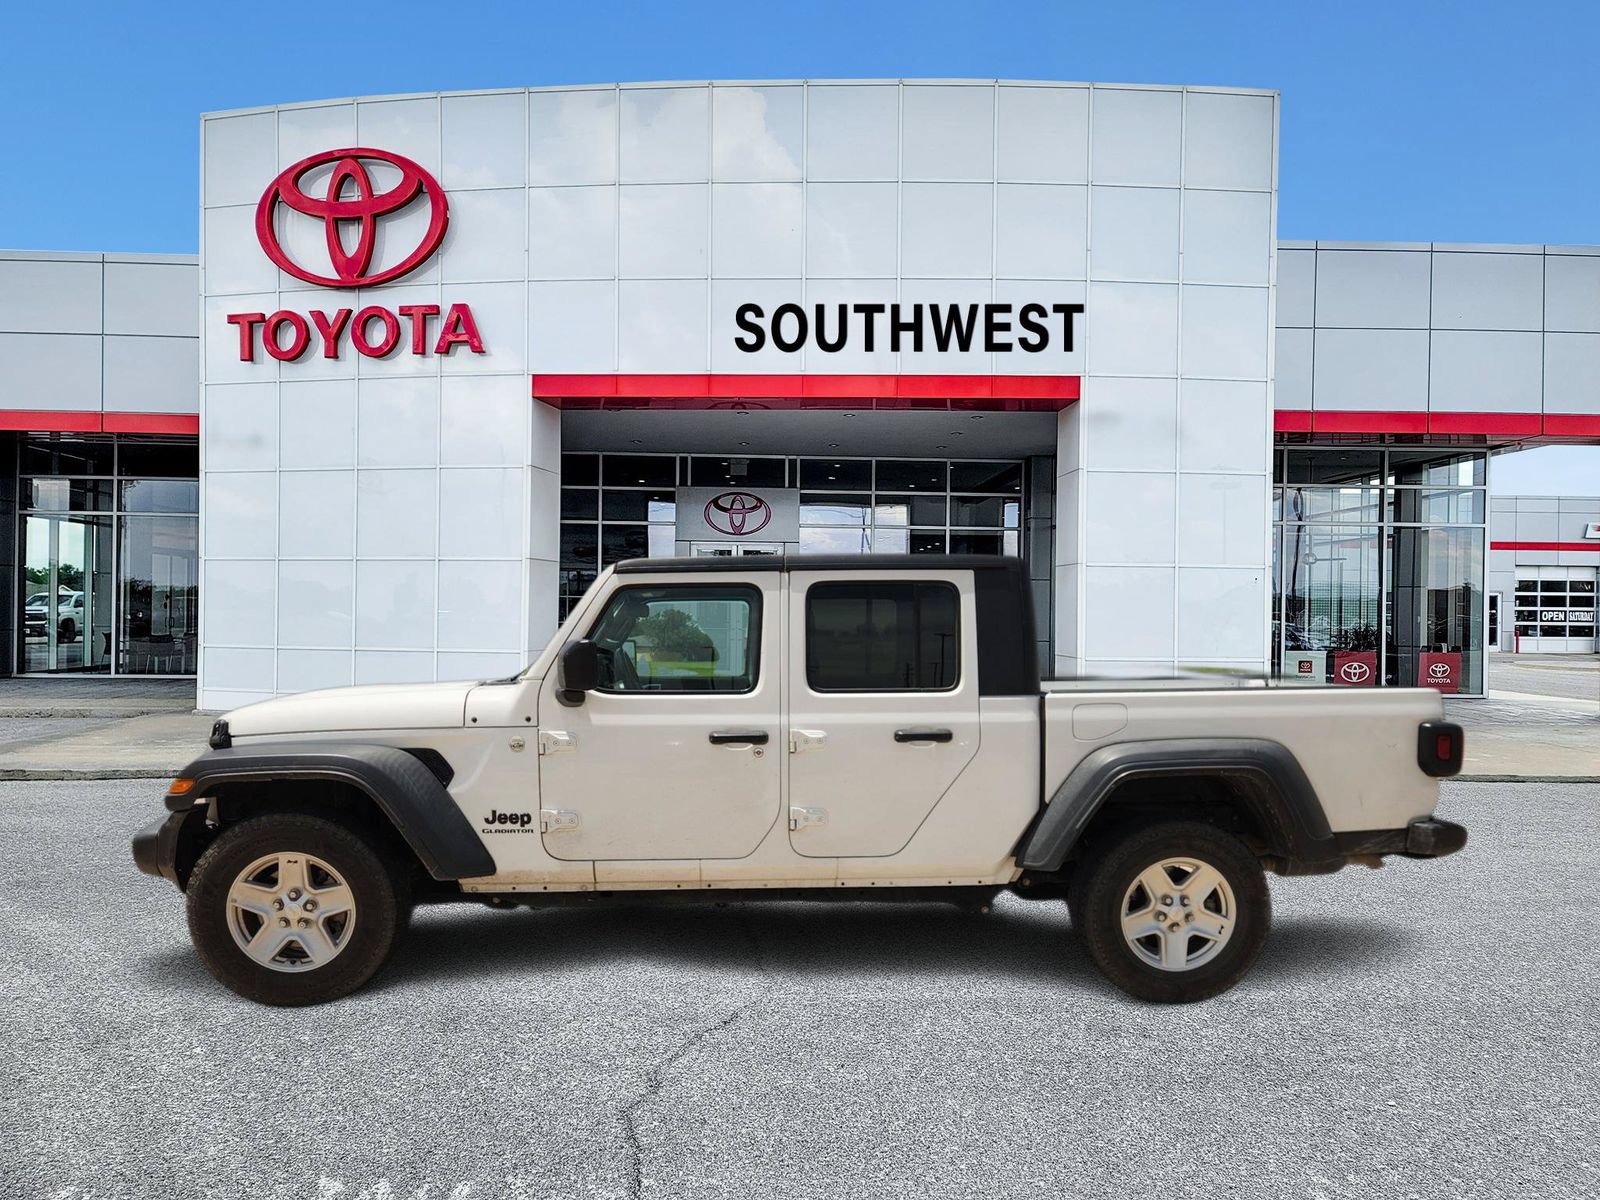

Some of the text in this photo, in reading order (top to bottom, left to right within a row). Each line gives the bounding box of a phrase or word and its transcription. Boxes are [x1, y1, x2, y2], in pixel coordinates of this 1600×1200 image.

[227, 303, 486, 362] TOYOTA
[734, 303, 1085, 353] SOUTHWEST
[1541, 611, 1565, 621] OPEN
[484, 809, 532, 828] Jeep
